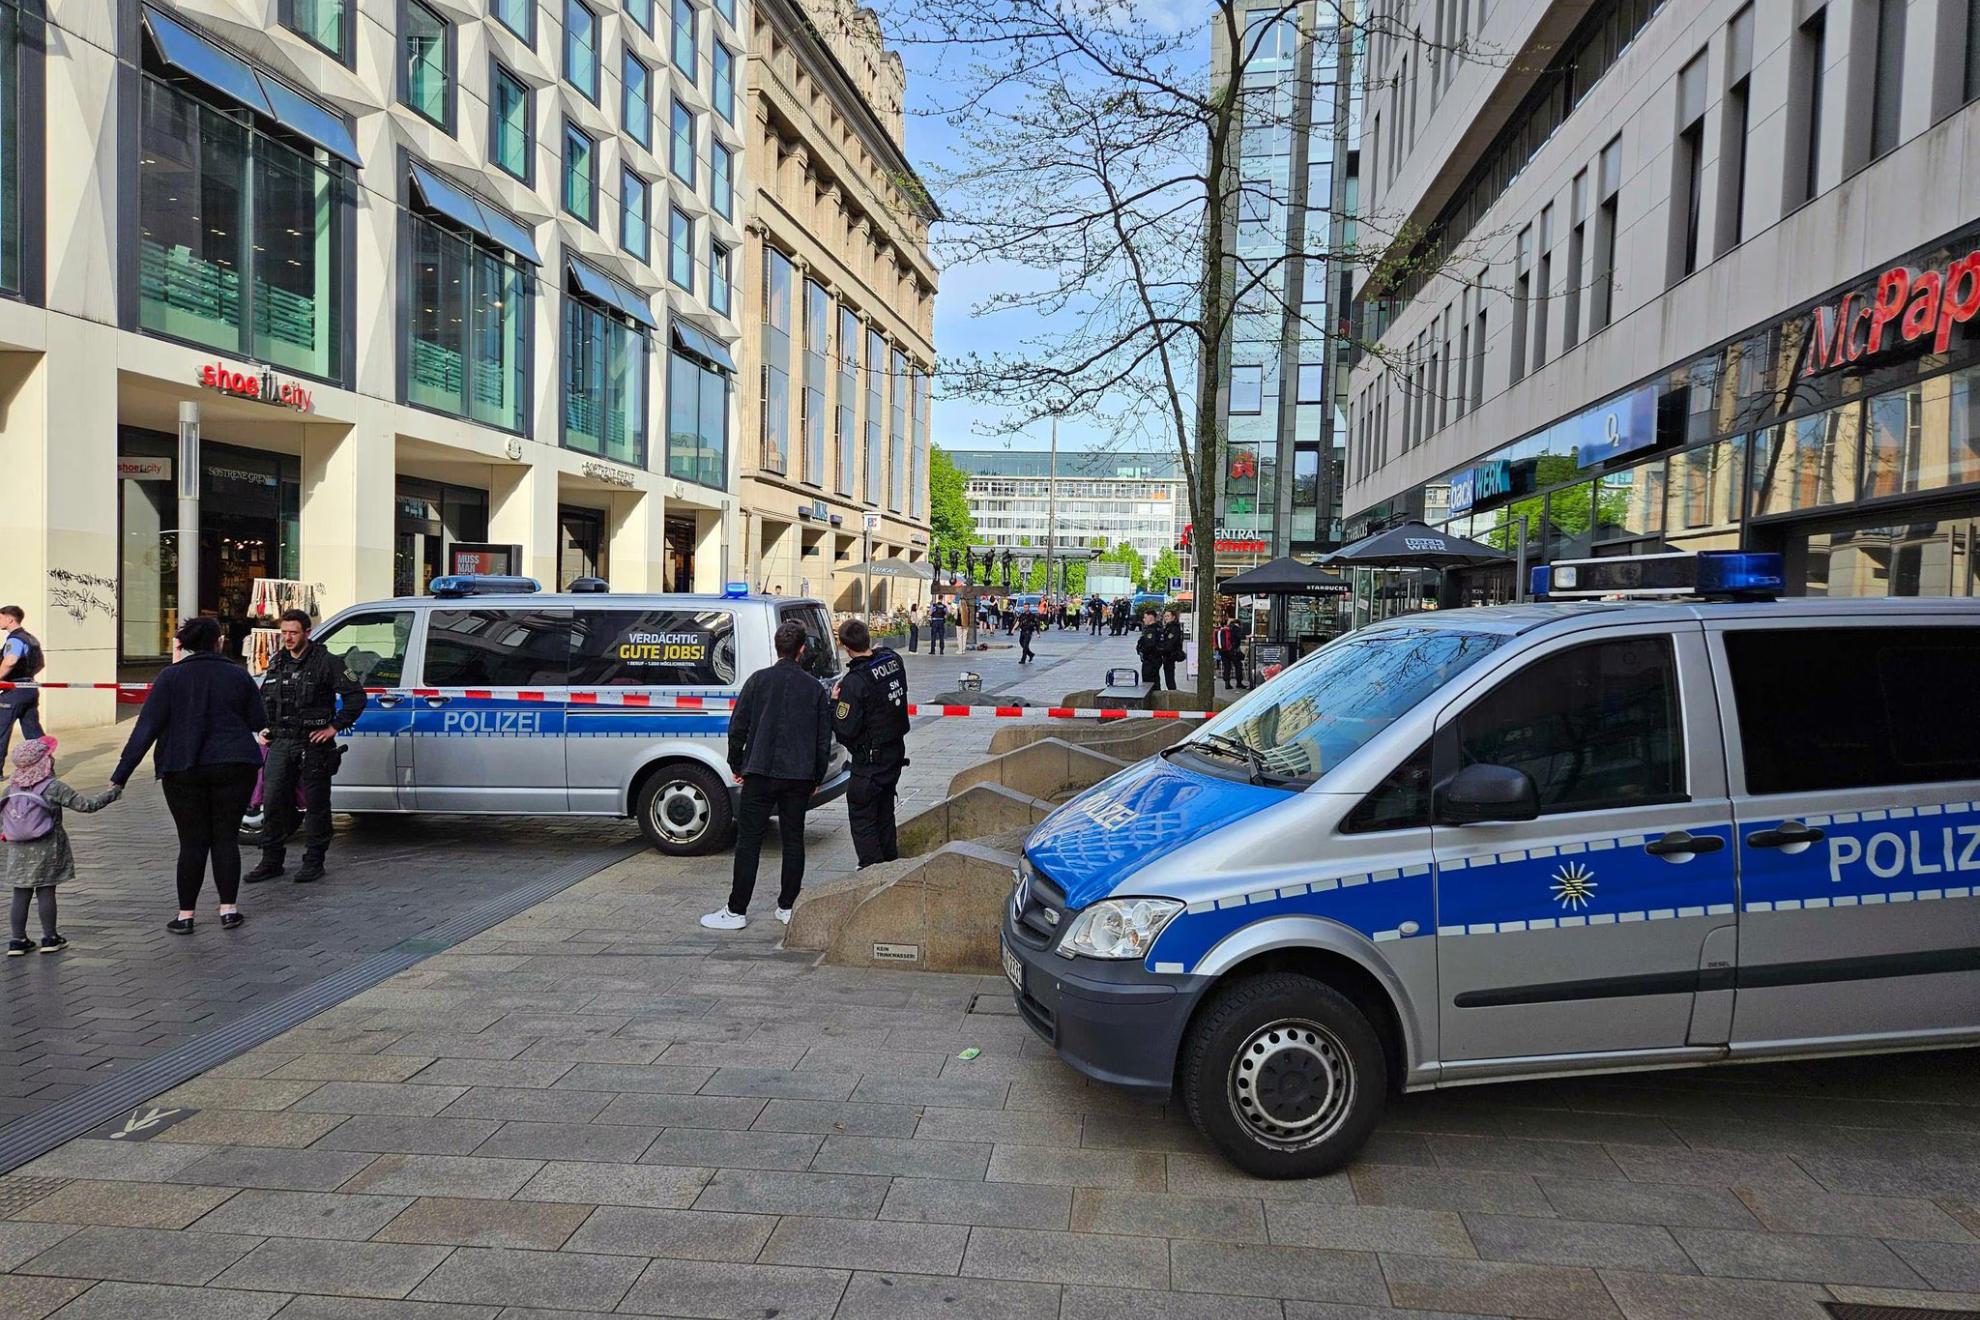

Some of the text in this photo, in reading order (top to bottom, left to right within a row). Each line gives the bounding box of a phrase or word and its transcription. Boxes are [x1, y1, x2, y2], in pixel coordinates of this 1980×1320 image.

[203, 361, 312, 412] shoe city
[1475, 460, 1504, 501] WERK
[1214, 527, 1261, 540] ENTRAL
[1214, 540, 1265, 553] OTHEKE
[457, 554, 480, 564] MUSS
[457, 563, 476, 573] MAN
[1306, 584, 1348, 592] STARBUCKS
[628, 631, 698, 644] VERDÄCHTIG
[620, 644, 705, 660] GUTE JOBS!
[889, 679, 900, 690] SN
[444, 711, 541, 732] POLIZEI
[1828, 824, 1980, 882] POLIZ
